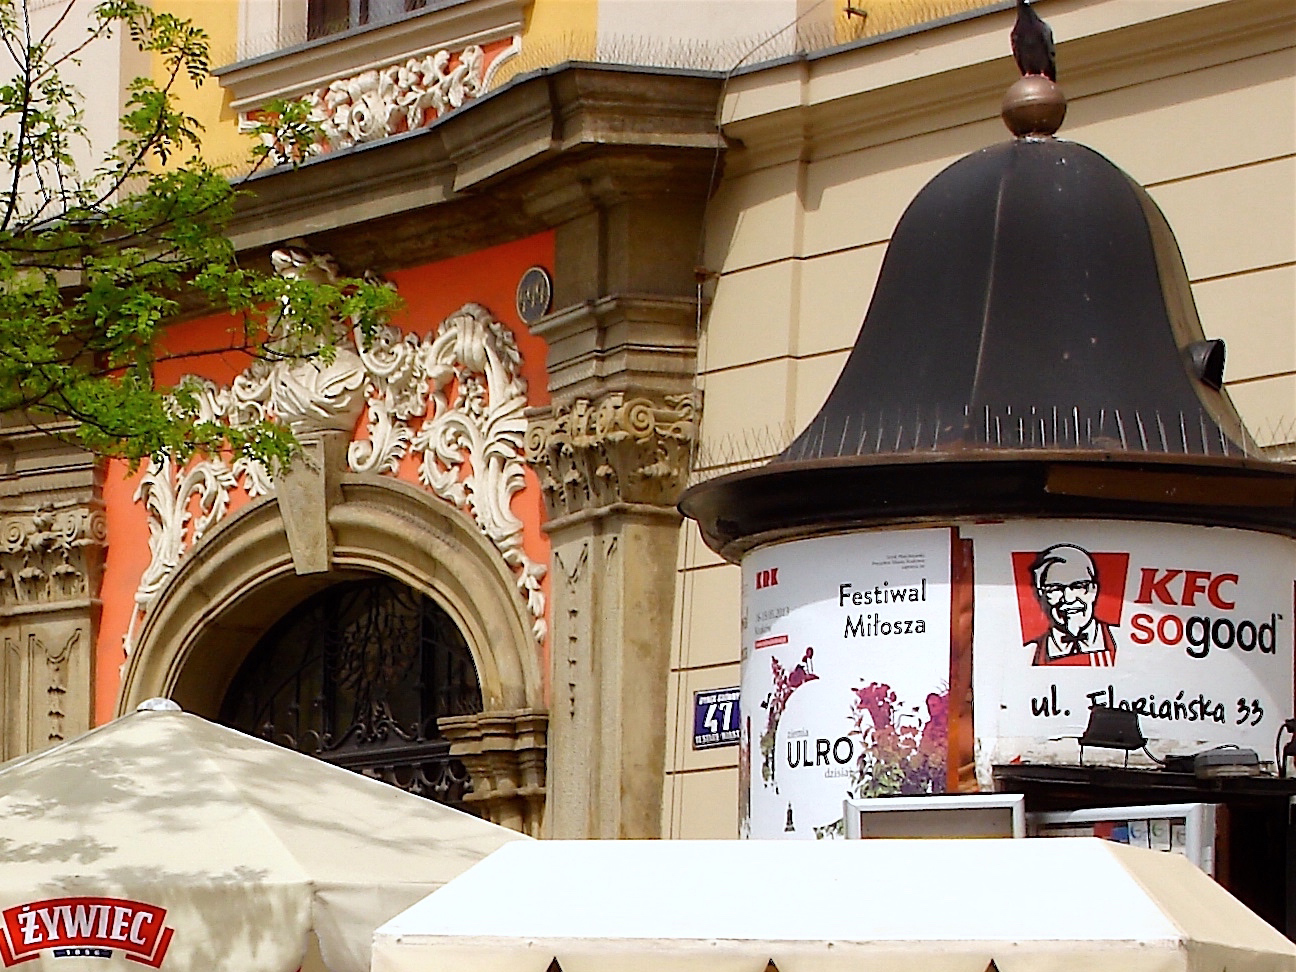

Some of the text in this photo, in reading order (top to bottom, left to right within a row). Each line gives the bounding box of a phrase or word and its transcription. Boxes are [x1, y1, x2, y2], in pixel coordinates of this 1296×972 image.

[839, 578, 926, 607] Festiwal
[1134, 568, 1238, 610] KFC
[844, 613, 926, 638] Miłosza
[704, 702, 733, 733] 47
[1031, 685, 1070, 716] ul.
[1236, 698, 1264, 726] 33
[787, 737, 854, 769] ULRO
[18, 905, 154, 946] ŻYWIEC
